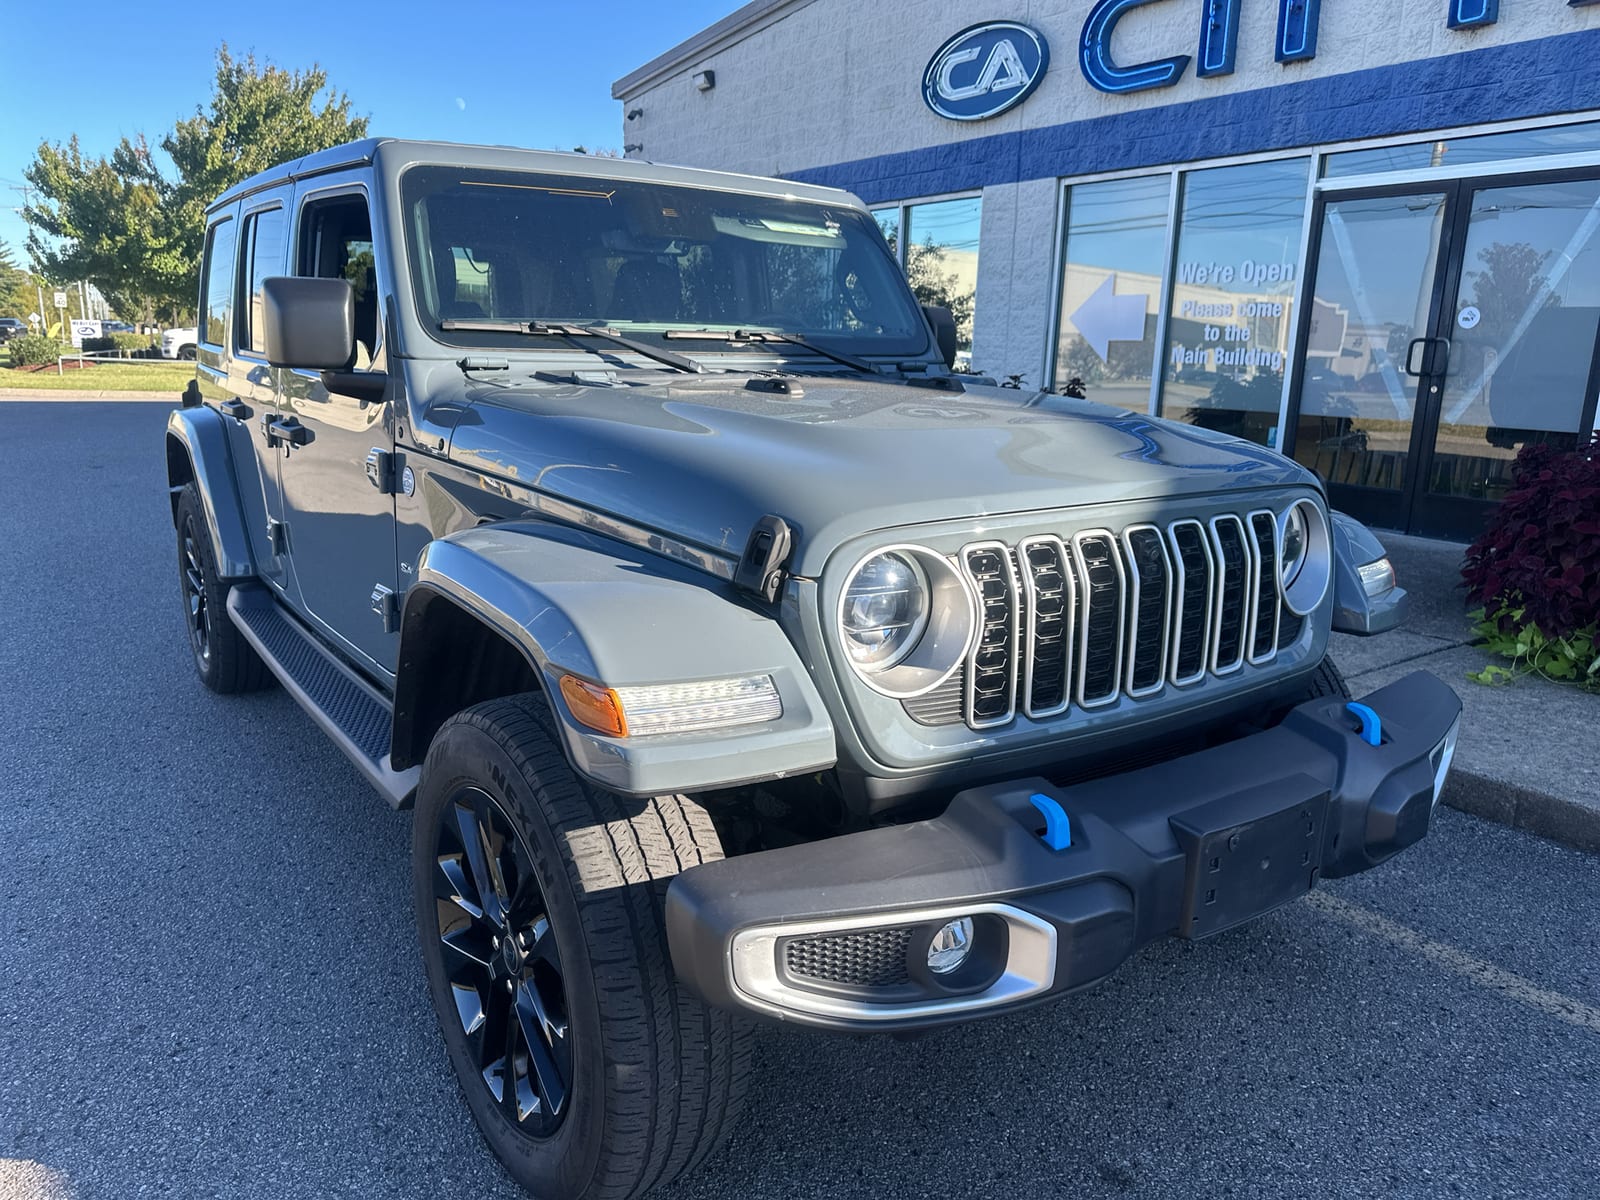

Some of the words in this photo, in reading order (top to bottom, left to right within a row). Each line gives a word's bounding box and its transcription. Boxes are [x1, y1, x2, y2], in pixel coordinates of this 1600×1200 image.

[936, 39, 1030, 101] CA
[1180, 262, 1235, 284] We're
[1240, 260, 1295, 286] Open
[1181, 301, 1233, 317] Please
[1237, 302, 1282, 317] come
[1204, 324, 1220, 341] to
[1224, 323, 1251, 341] the
[1171, 346, 1208, 365] Main
[1214, 347, 1284, 371] Building
[491, 764, 555, 889] NEXEN
